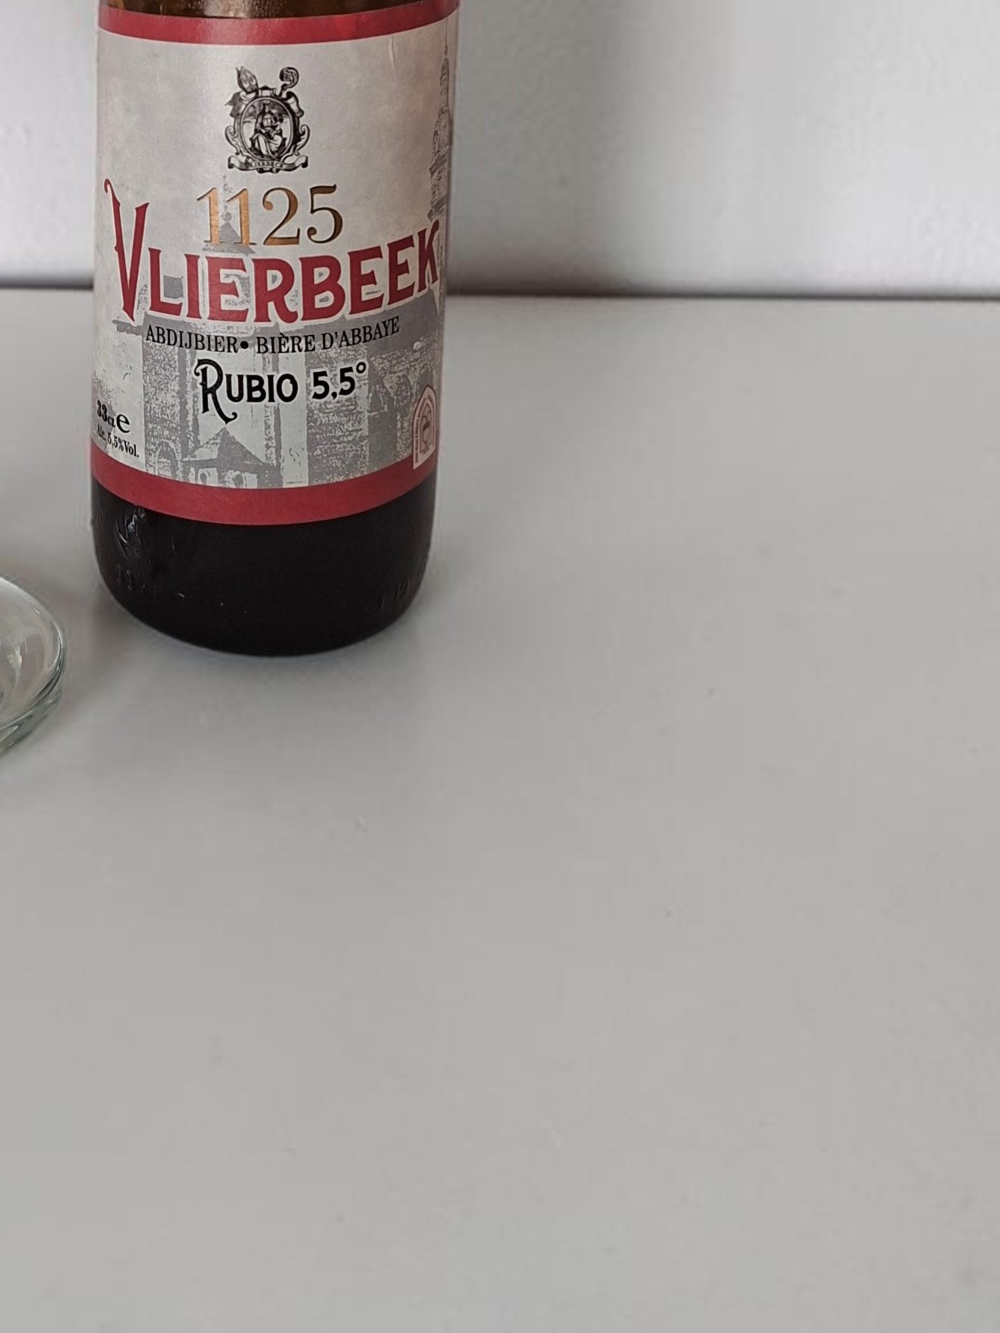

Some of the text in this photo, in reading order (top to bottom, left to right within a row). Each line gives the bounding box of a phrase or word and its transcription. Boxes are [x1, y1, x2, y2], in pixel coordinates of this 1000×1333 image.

[196, 184, 343, 247] 1125
[103, 178, 440, 324] VLIERBEEK
[256, 333, 316, 355] BIÈRE
[321, 316, 400, 350] D'ABBAYE
[194, 358, 299, 425] RUBIO
